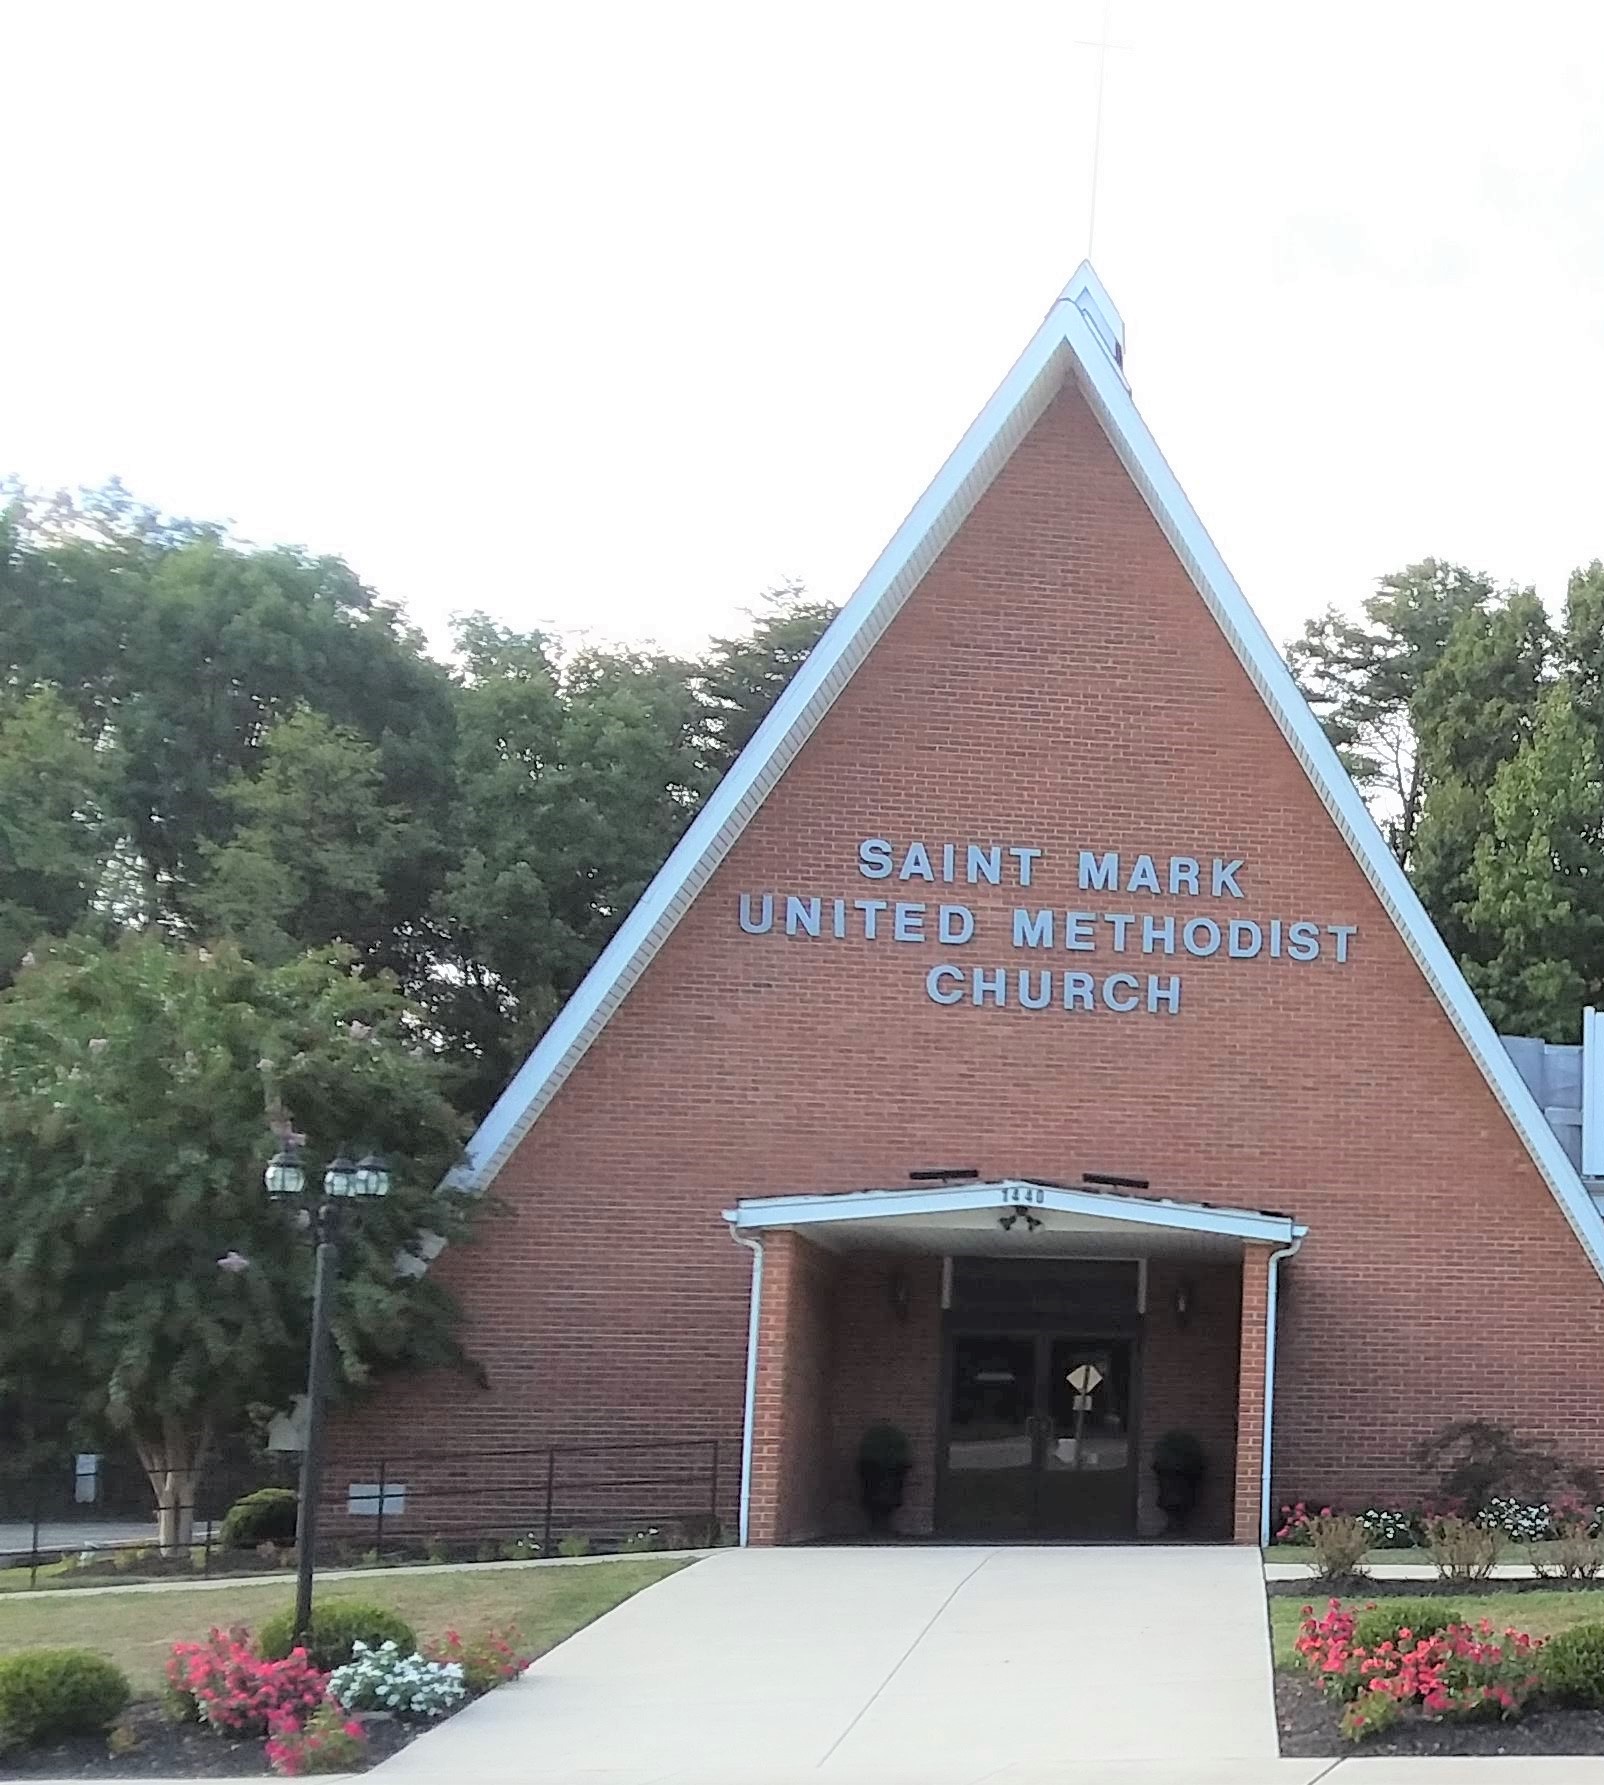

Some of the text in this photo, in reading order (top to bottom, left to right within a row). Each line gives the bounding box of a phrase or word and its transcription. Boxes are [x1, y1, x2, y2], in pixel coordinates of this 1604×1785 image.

[858, 838, 1245, 898] SAINT MARK
[739, 893, 1358, 963] UNITED METHODIST
[926, 965, 1182, 1014] CHURCH
[1002, 1187, 1045, 1204] 1440
